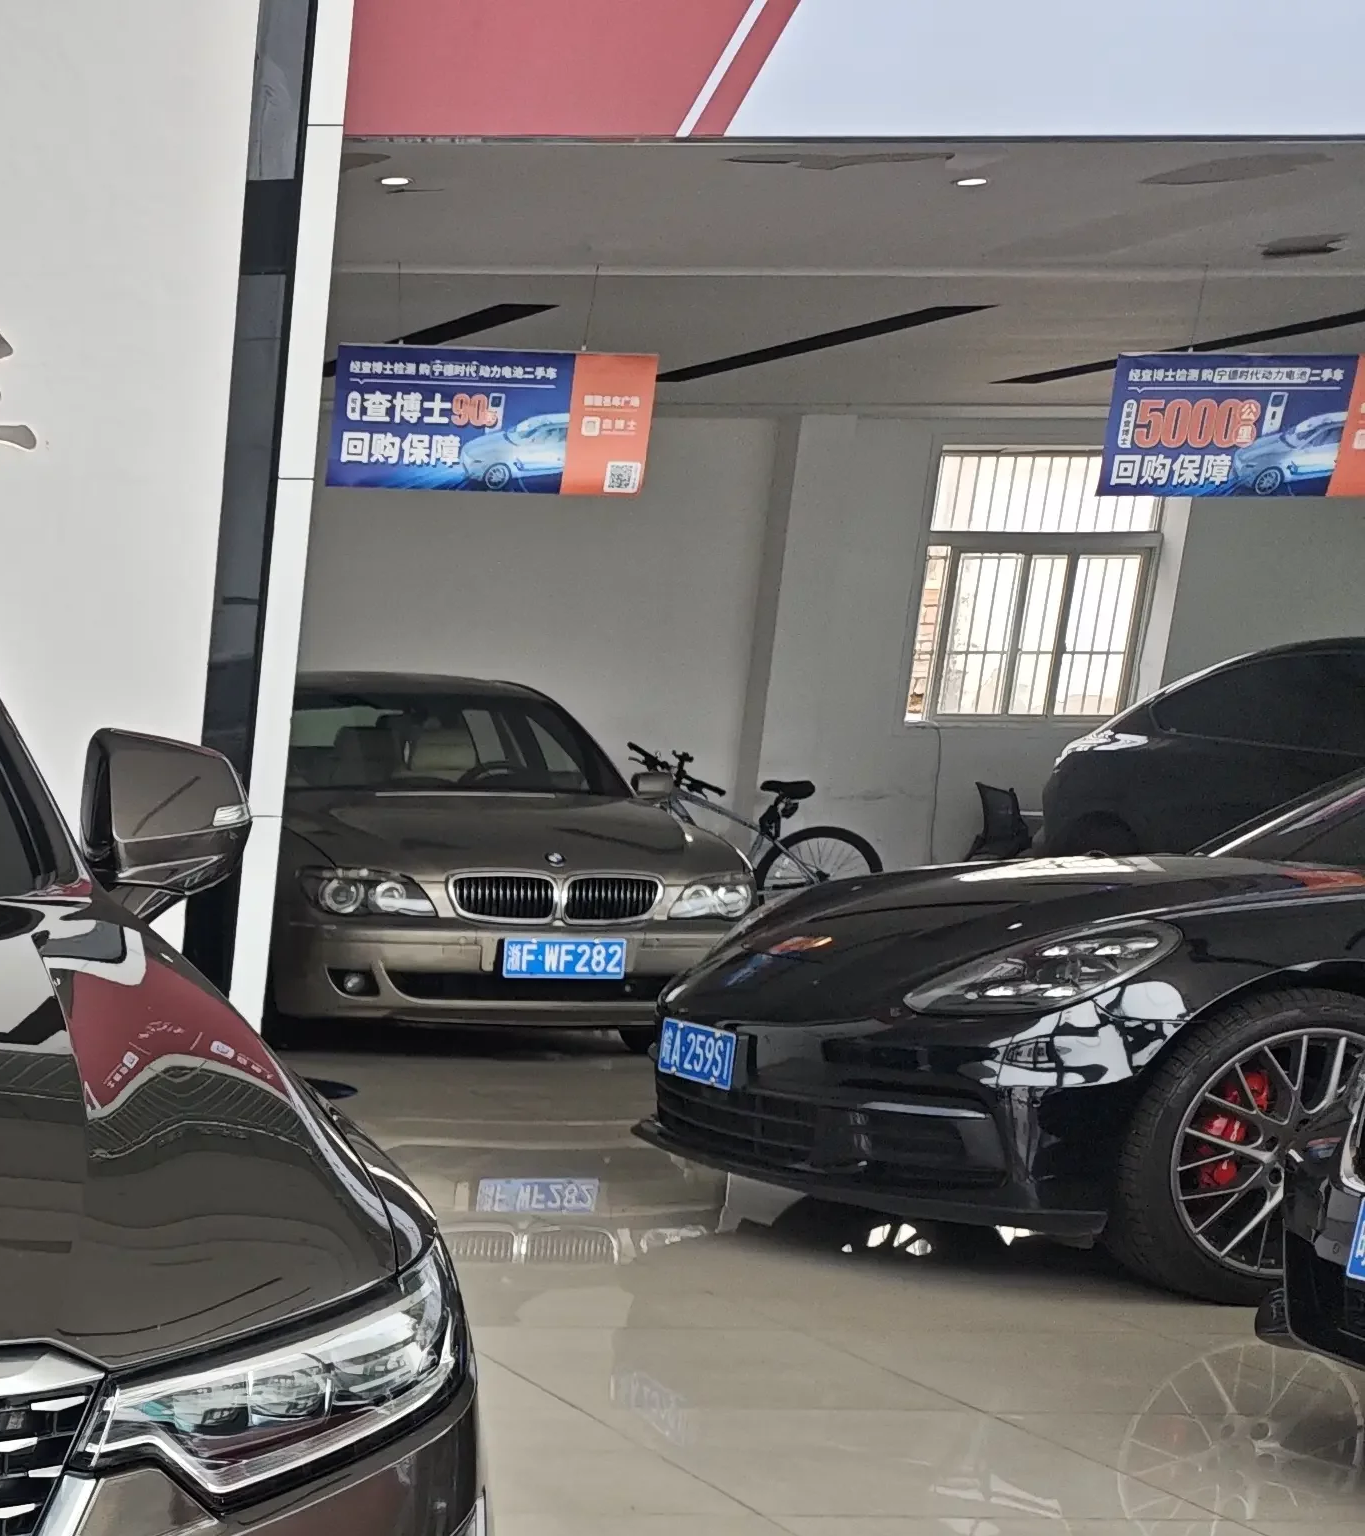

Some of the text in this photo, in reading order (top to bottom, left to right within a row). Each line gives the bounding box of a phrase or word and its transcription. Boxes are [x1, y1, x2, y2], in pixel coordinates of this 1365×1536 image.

[340, 432, 461, 466] 回购保障
[1109, 454, 1232, 487] 回购保障
